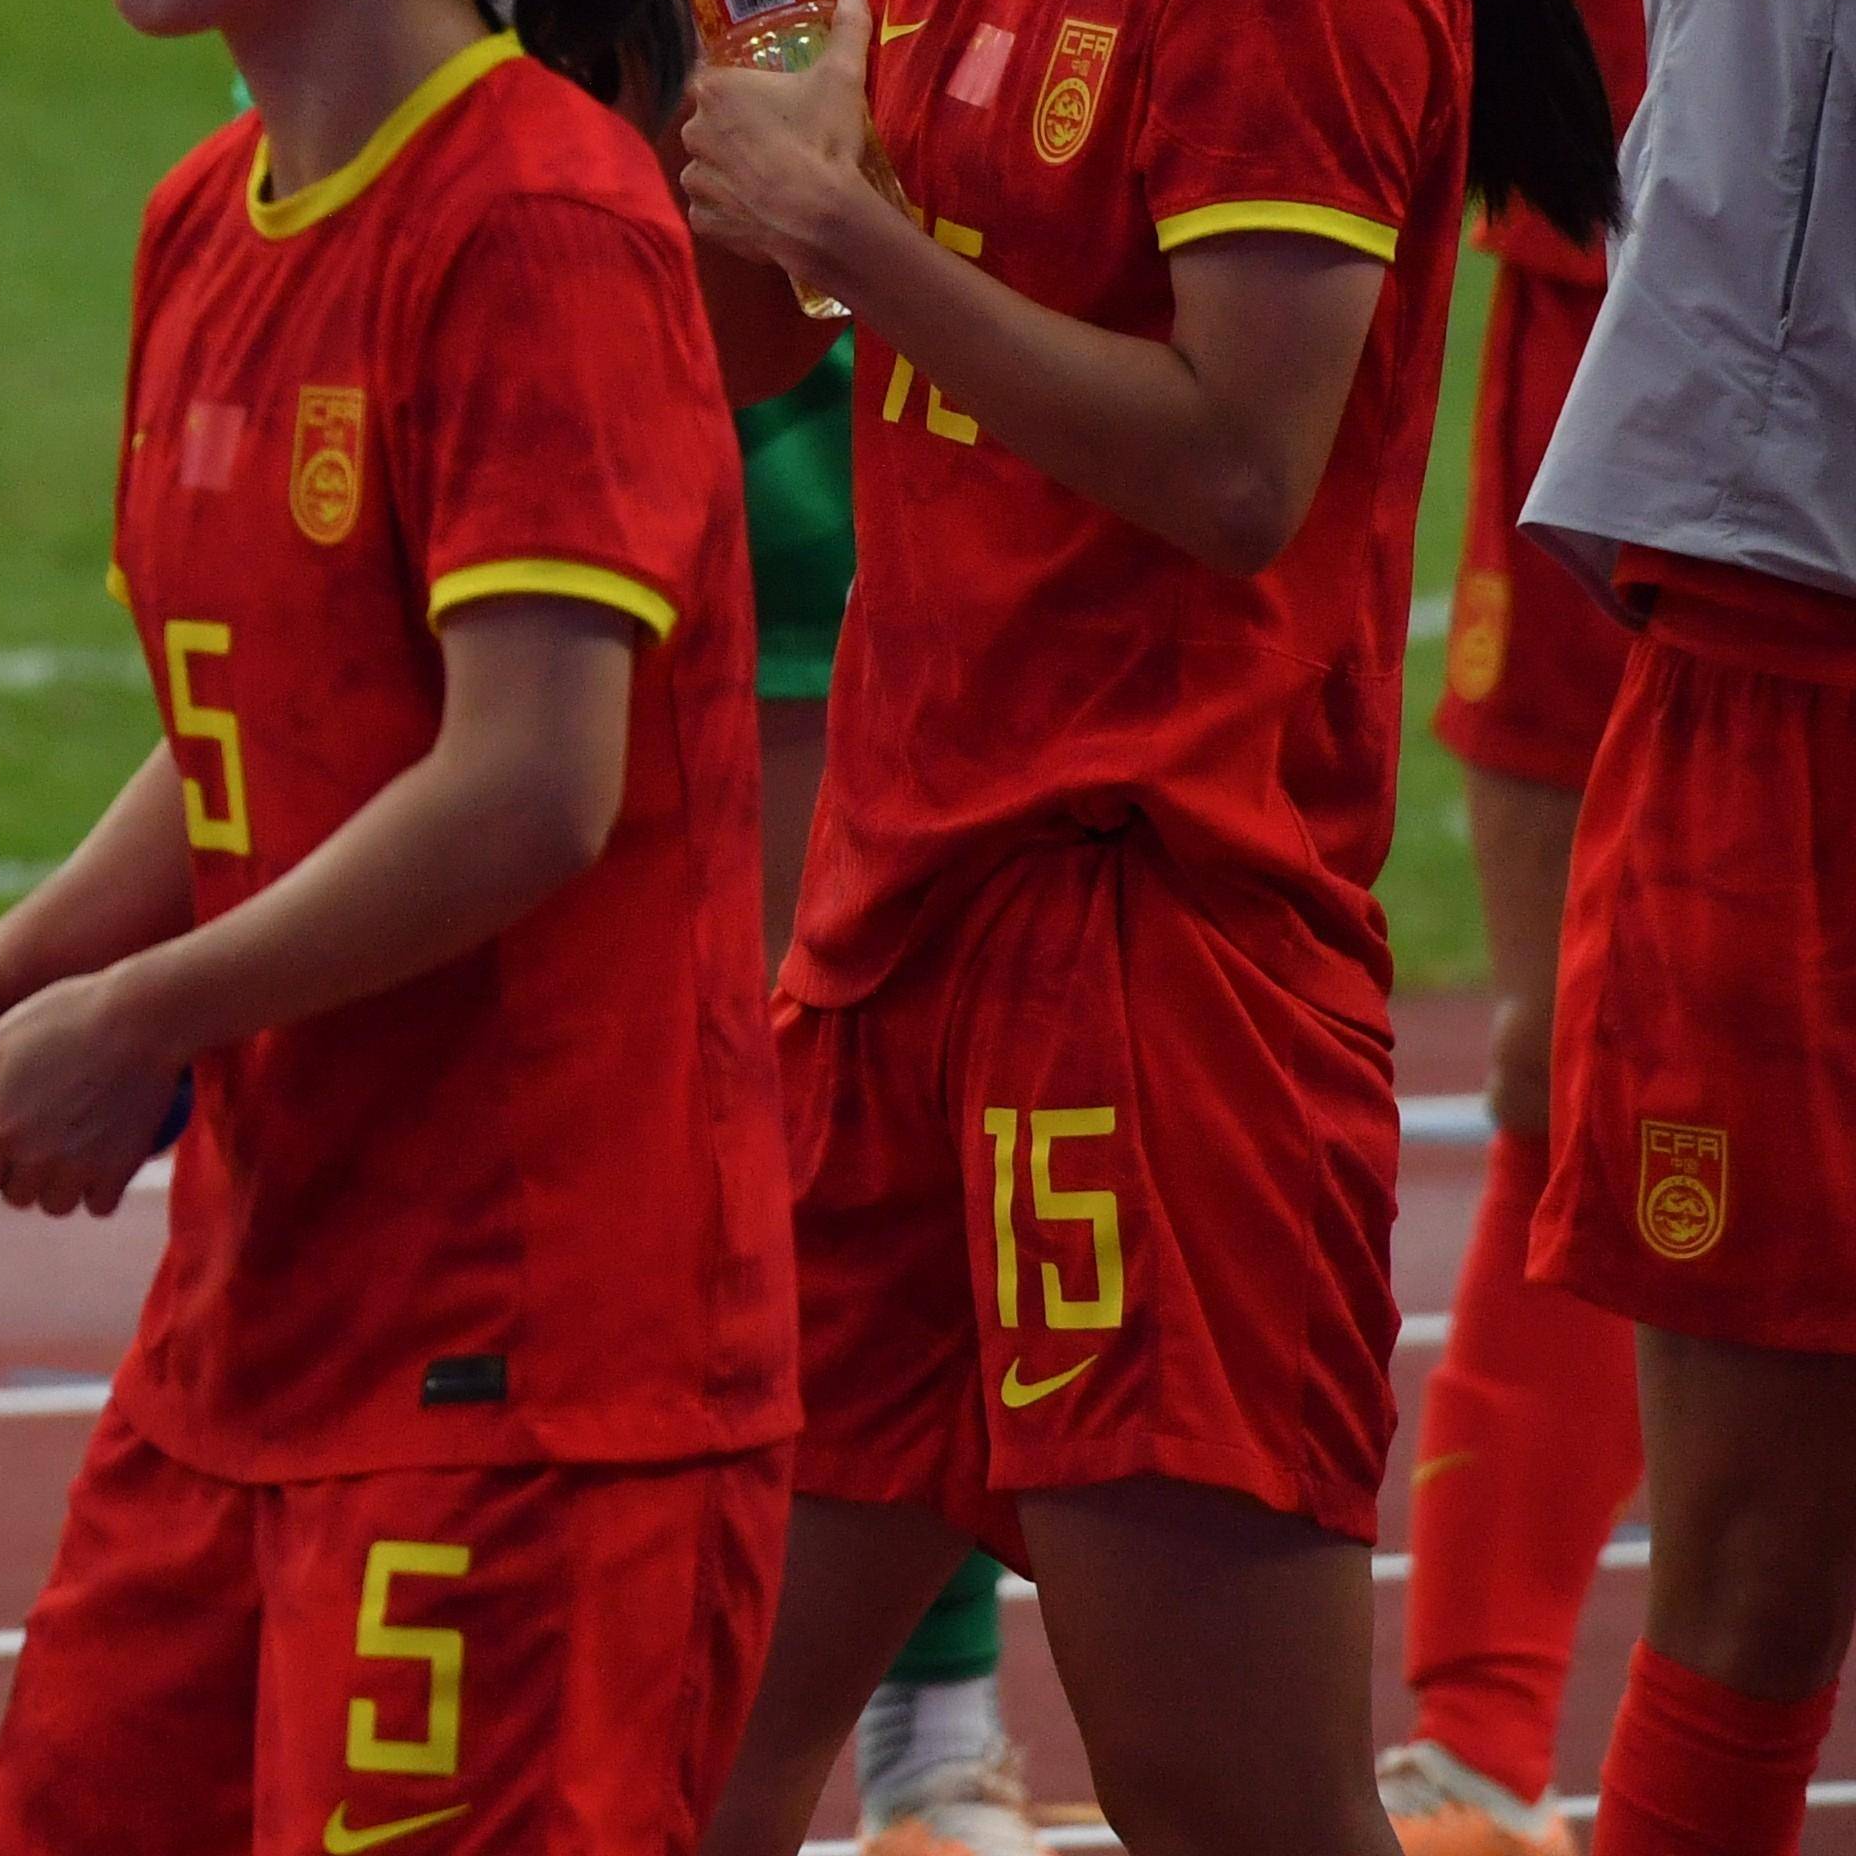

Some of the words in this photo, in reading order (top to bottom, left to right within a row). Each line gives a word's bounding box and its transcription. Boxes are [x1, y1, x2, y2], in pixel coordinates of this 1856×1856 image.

[1061, 30, 1110, 61] CFA
[164, 619, 252, 856] 5
[984, 1106, 1124, 1329] 15
[1650, 1129, 1718, 1160] CFA
[346, 1540, 471, 1776] 5
